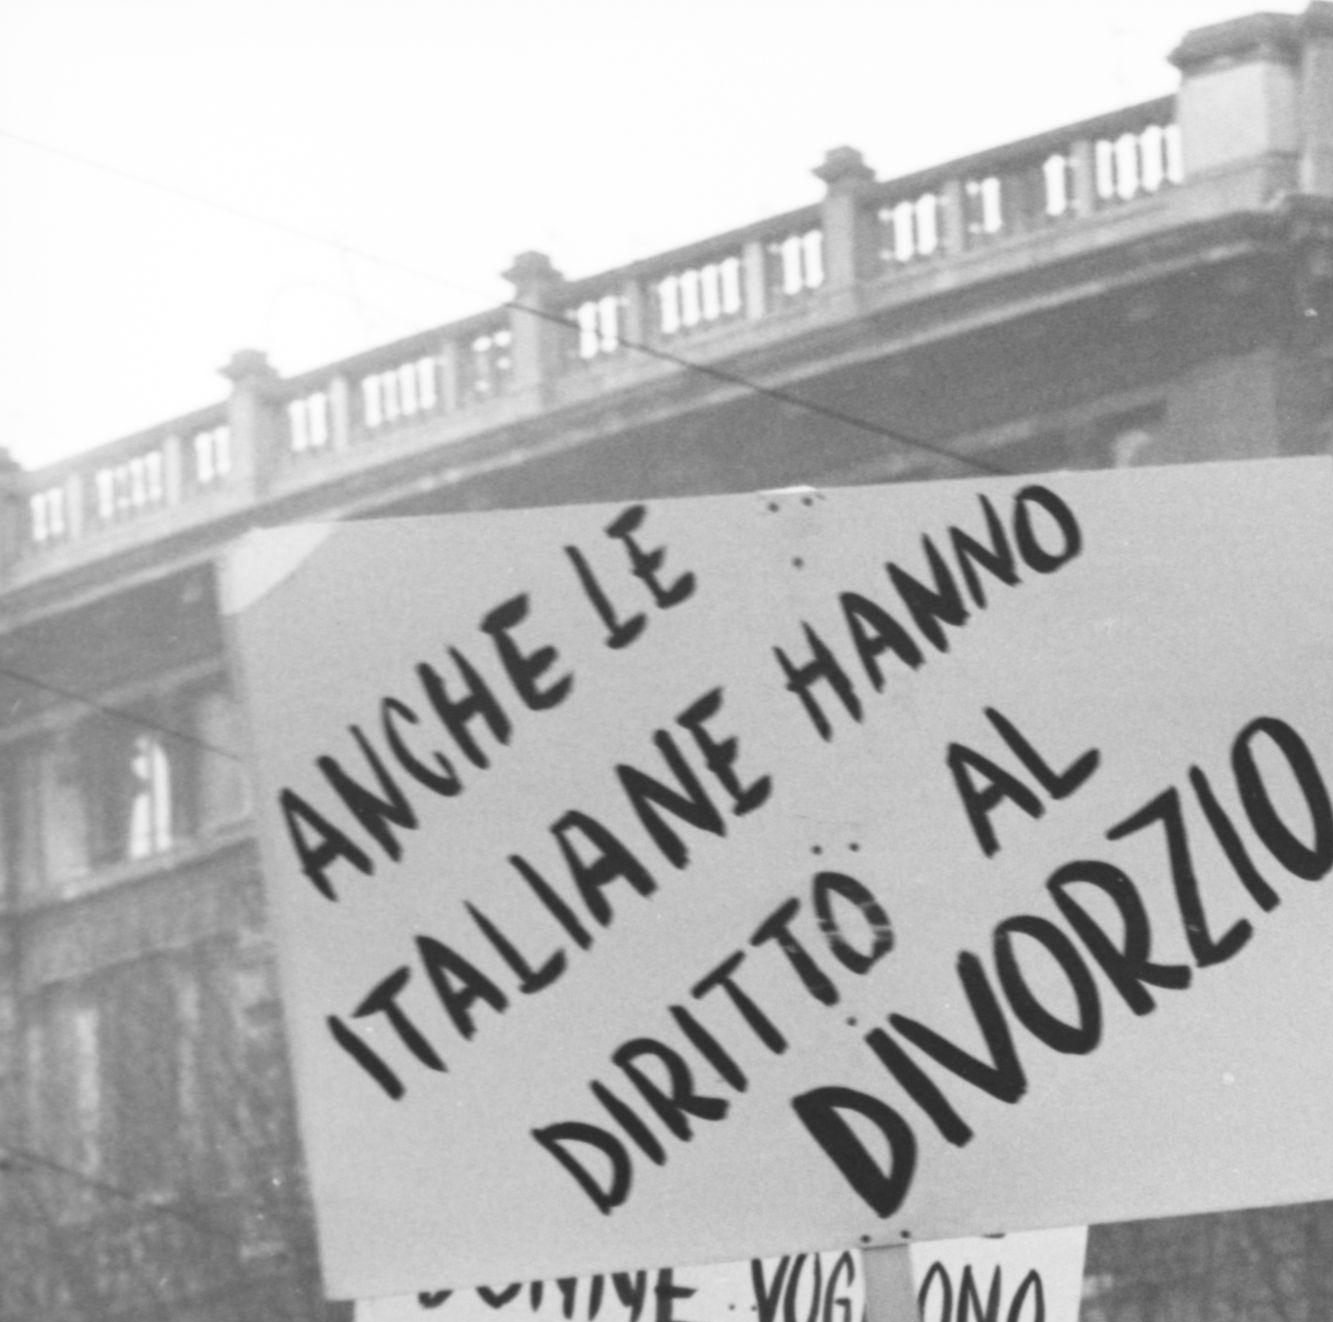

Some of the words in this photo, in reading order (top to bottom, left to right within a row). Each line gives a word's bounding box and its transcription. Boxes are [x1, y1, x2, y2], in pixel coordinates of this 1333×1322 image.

[277, 592, 575, 901] ANCHE
[564, 504, 695, 648] LE
[326, 685, 772, 1101] ITALIANE
[772, 483, 1083, 742] HANNO
[530, 869, 895, 1216] DIRITTO
[946, 705, 1102, 857] AL
